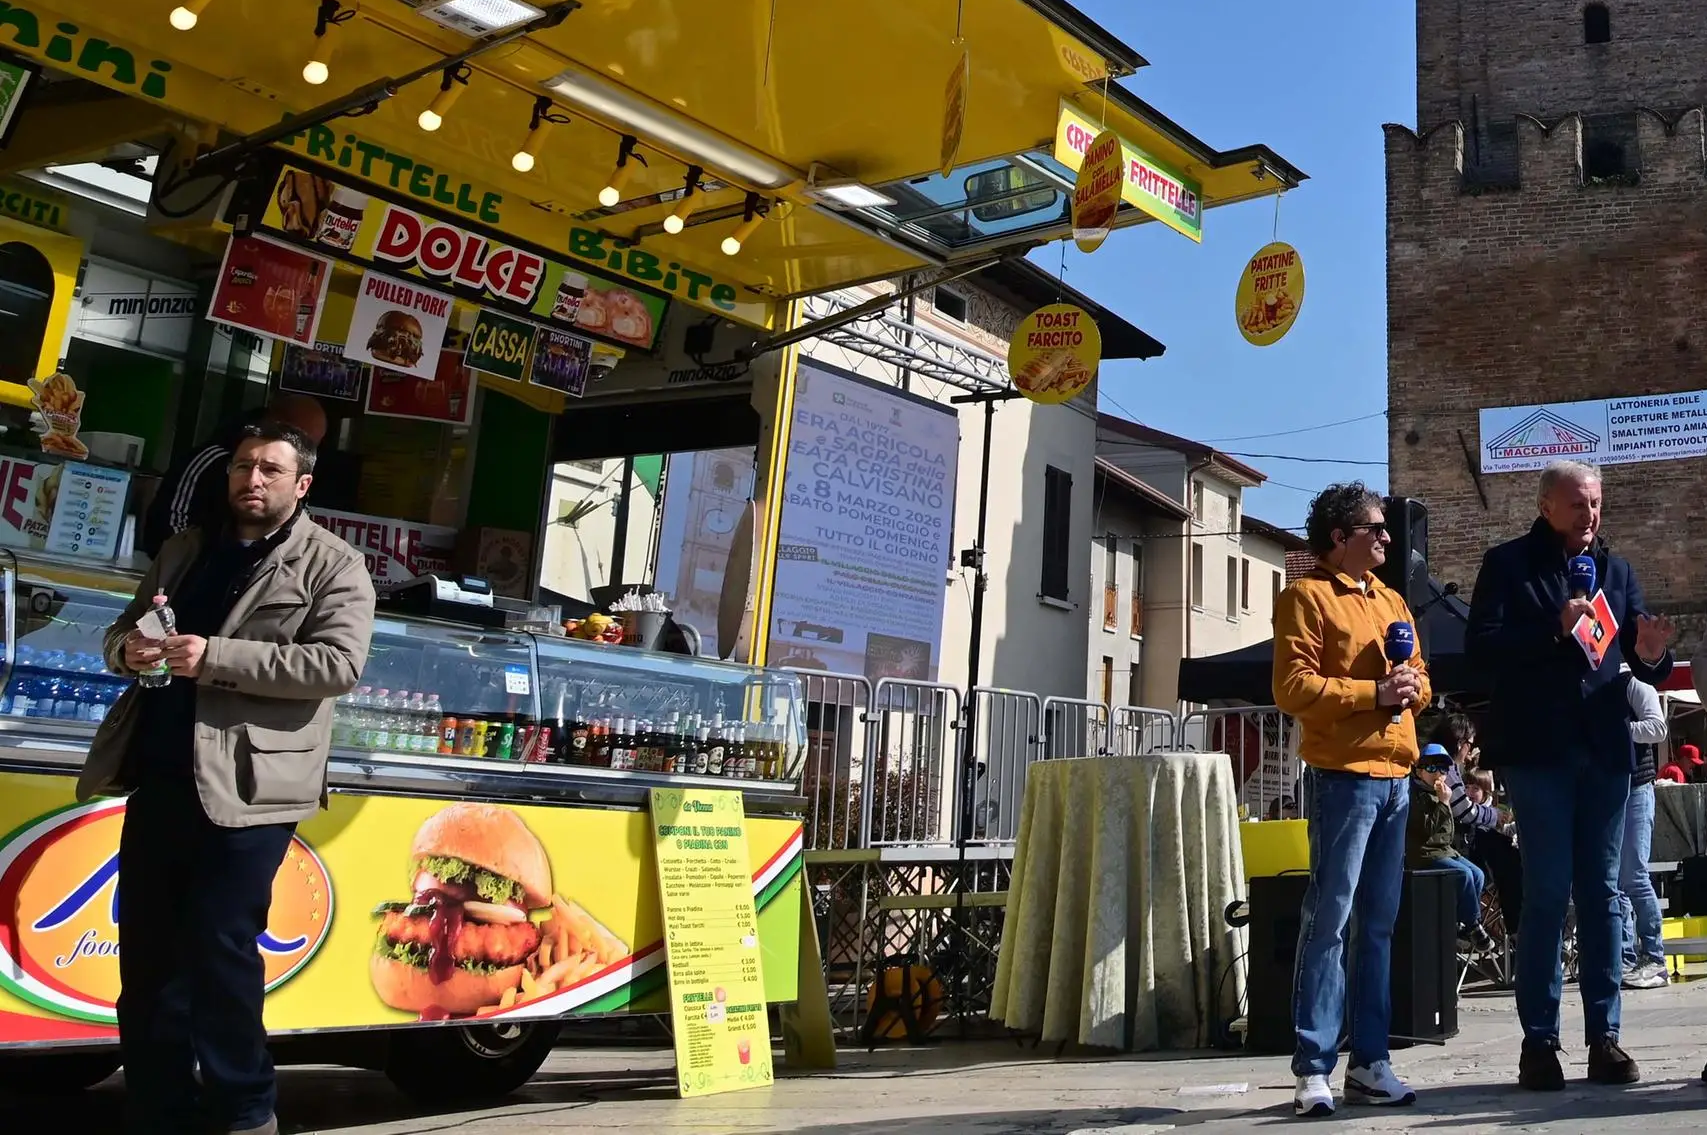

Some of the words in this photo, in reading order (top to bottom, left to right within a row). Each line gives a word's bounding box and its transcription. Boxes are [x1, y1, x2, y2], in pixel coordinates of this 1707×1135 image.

[0, 1, 172, 99] nini
[1066, 123, 1094, 155] CRE
[1130, 159, 1195, 215] FRITTELLE
[1084, 138, 1115, 170] PANINO
[1075, 166, 1121, 208] SALAMELLA
[326, 214, 358, 232] nutella
[375, 209, 542, 302] DOLCE
[1251, 250, 1295, 274] PATATINE
[366, 276, 412, 309] PULLED
[412, 294, 449, 319] PORK
[1254, 271, 1287, 293] FRITTE
[556, 294, 580, 307] nutella
[1036, 312, 1081, 328] TOAST
[315, 342, 345, 355] ORTIN
[472, 323, 528, 365] CASSA
[550, 332, 583, 350] SHORTINI
[1028, 331, 1083, 347] FARCITO
[1610, 399, 1670, 411] LATTONERIA
[1673, 395, 1700, 405] EDILE
[1611, 411, 1669, 425] COPERTURE
[797, 409, 840, 434] ERA
[846, 428, 946, 466] AGRICOLA
[1611, 424, 1681, 439] SMALTIMENTO
[1613, 440, 1656, 452] IMPIANTI
[815, 435, 827, 446] e
[834, 436, 900, 466] SAGRA
[906, 460, 945, 480] della
[1503, 444, 1583, 457] MACCABIANI
[792, 440, 848, 467] EATA
[855, 458, 944, 494] CRISTINA
[812, 461, 943, 510] CALVISANO
[814, 479, 831, 499] 8
[837, 491, 900, 517] MARZO
[905, 509, 942, 528] 2026
[838, 505, 930, 538] POMERIGGIO
[312, 515, 421, 577] RITTELLE
[815, 525, 864, 547] TUTTO
[868, 539, 883, 552] IL
[884, 543, 938, 564] GIORNO
[864, 525, 940, 553] DOMENICA
